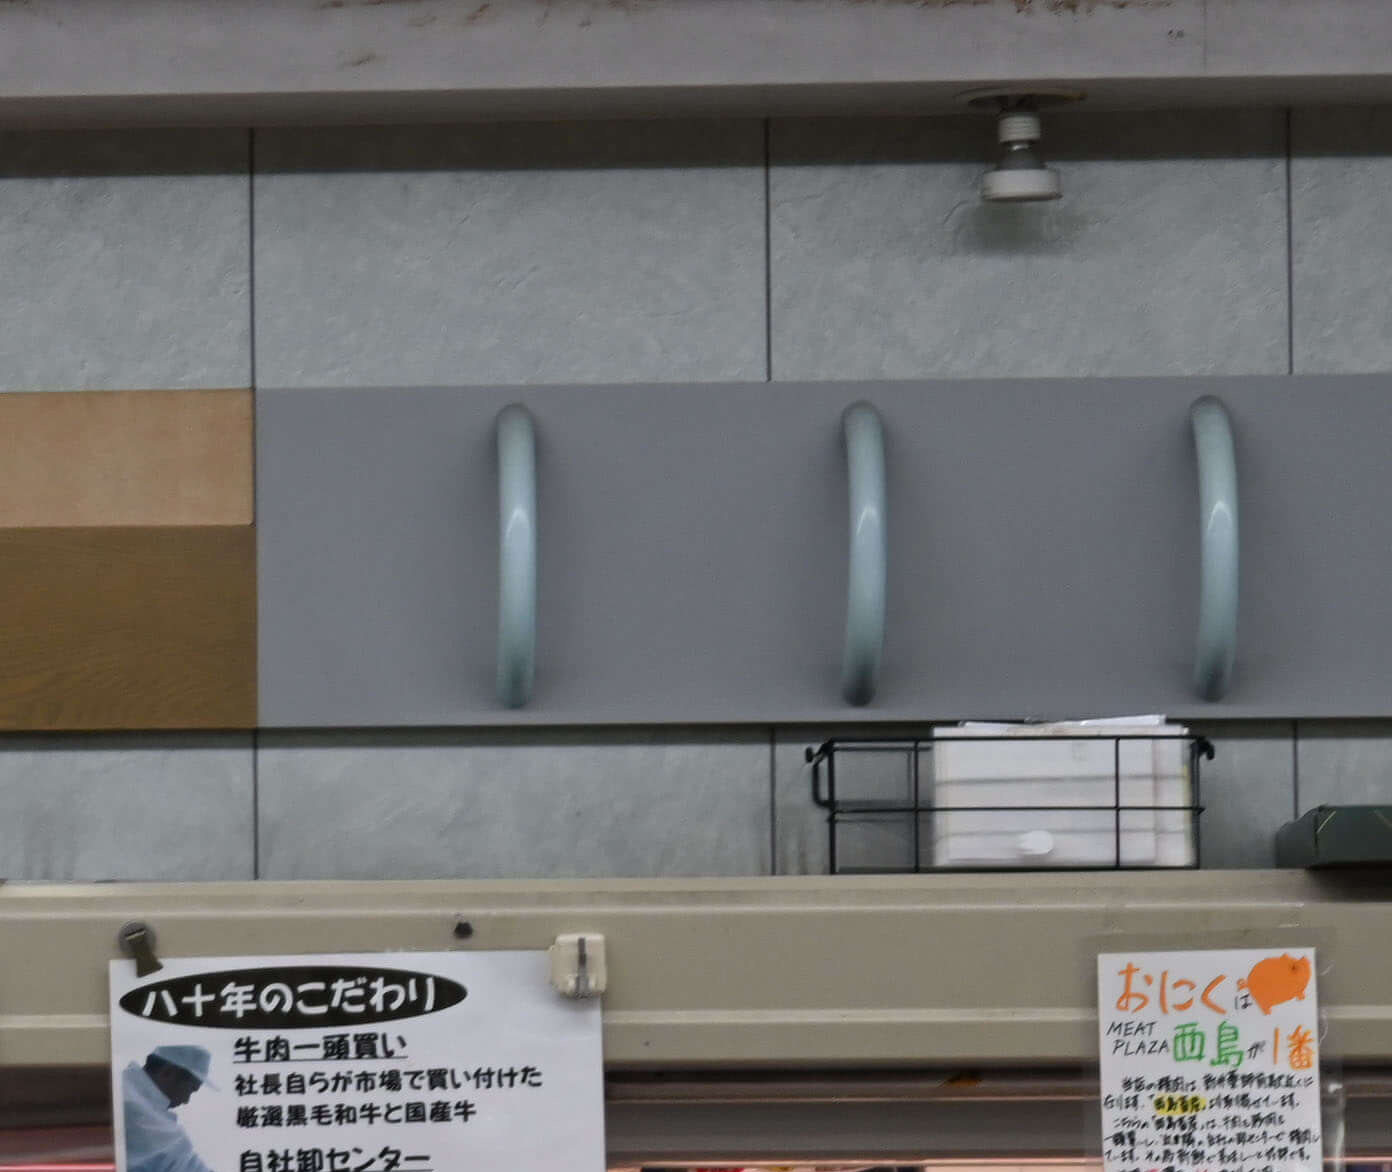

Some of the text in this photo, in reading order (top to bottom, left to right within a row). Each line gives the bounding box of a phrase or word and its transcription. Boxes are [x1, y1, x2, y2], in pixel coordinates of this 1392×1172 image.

[142, 974, 436, 1018] 八十年のこだわり
[1106, 1021, 1158, 1037] MEAT
[233, 1033, 408, 1062] 牛肉一頭買い
[1112, 1039, 1170, 1057] PLAZA
[234, 1064, 543, 1097] 社長自らが市場で買い付けた
[236, 1100, 477, 1129] 厳選黒毛和牛と国産牛
